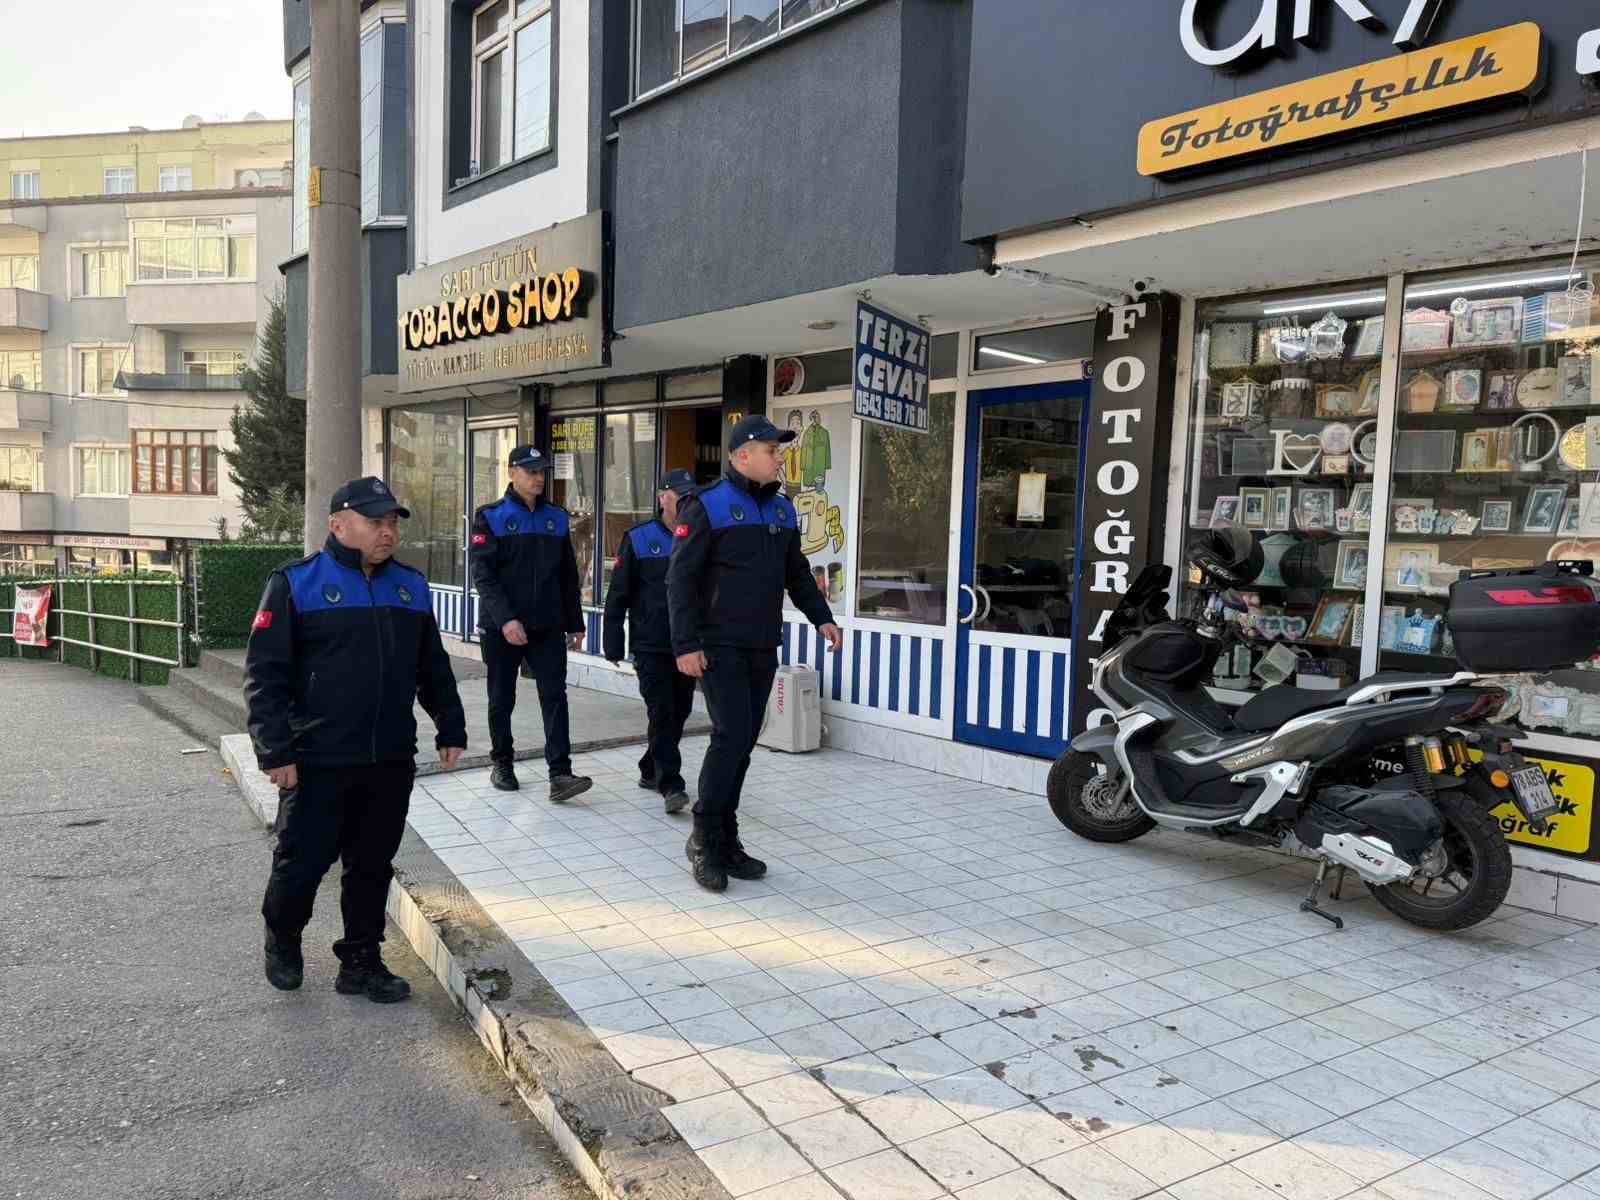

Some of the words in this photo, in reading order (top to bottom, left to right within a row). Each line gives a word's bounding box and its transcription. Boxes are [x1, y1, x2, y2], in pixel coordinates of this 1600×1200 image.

[1160, 46, 1503, 158] Fotoğrafçılık
[398, 288, 500, 350] TOBACCO
[507, 266, 581, 328] SHOP
[856, 389, 881, 418] 0543
[857, 352, 927, 403] CEVAT
